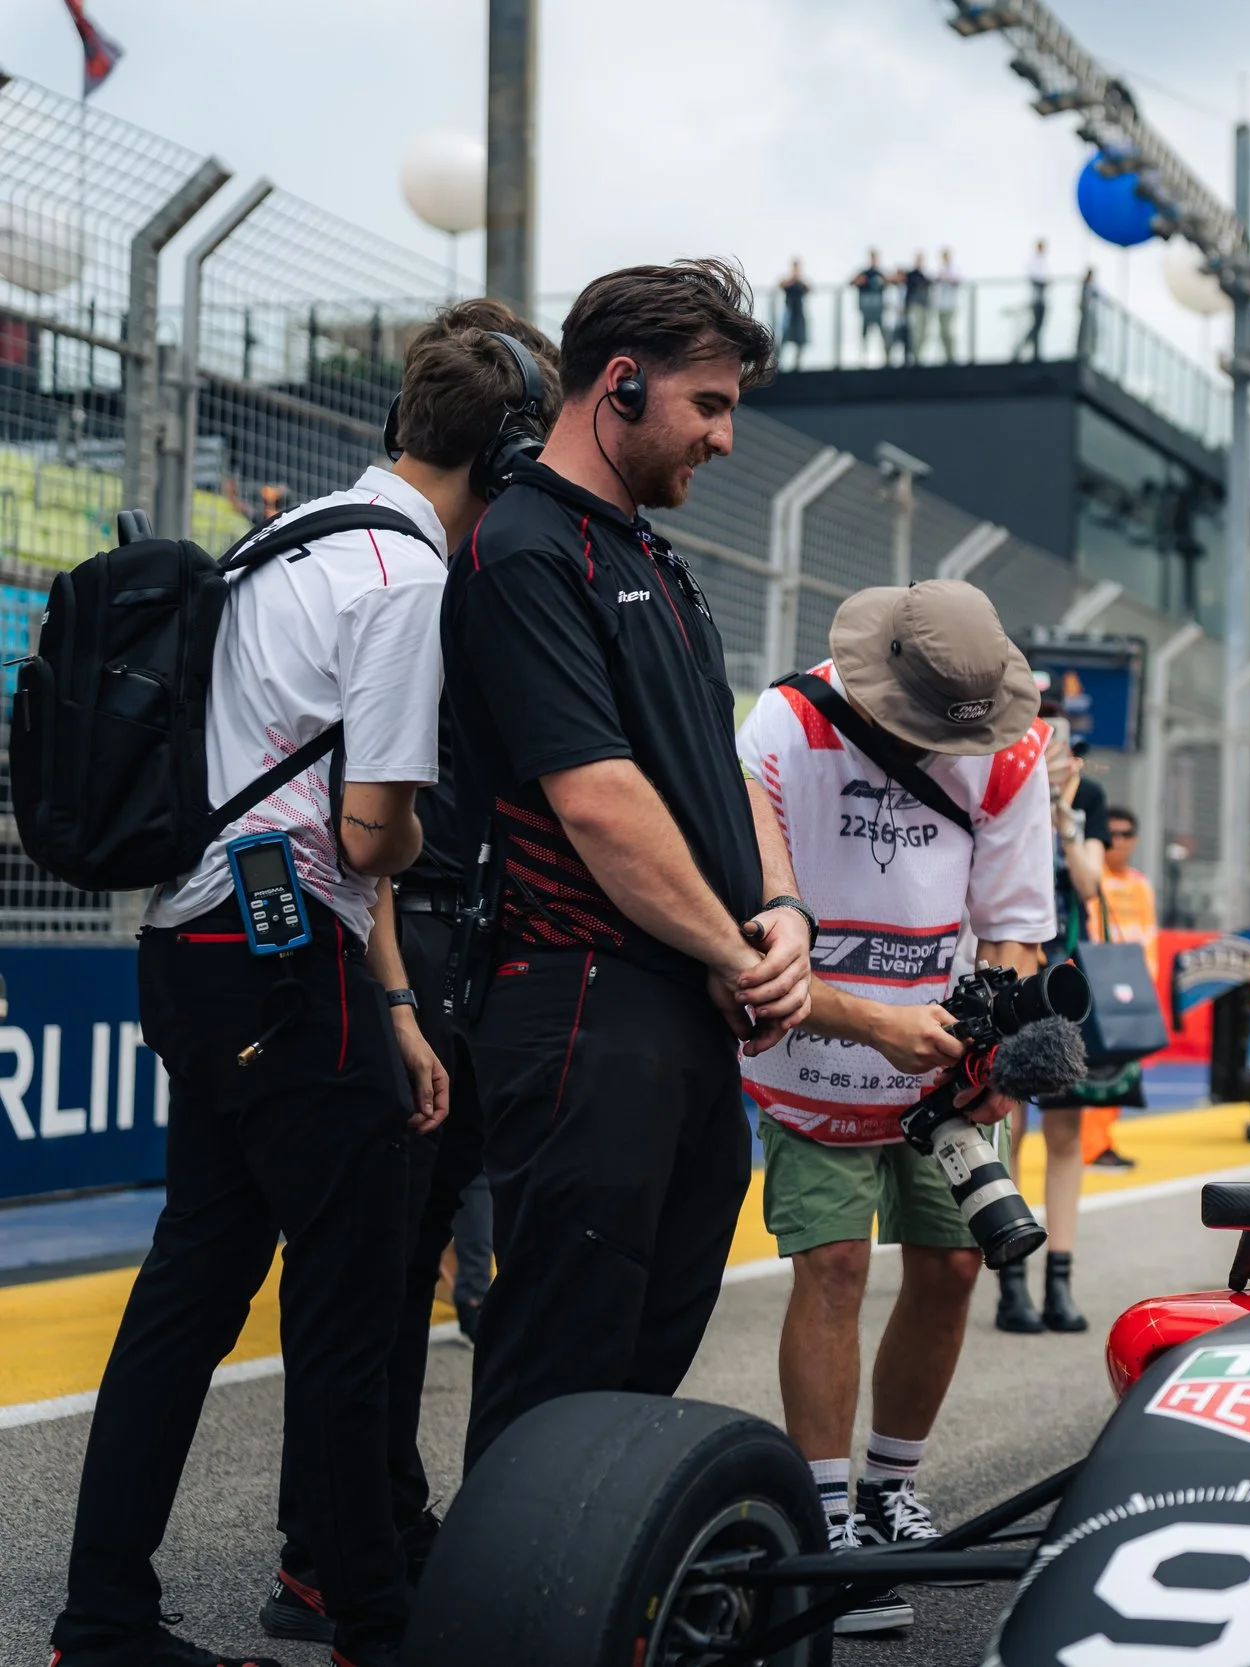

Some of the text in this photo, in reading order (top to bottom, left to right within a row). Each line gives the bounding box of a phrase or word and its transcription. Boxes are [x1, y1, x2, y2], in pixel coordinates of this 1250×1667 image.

[254, 886, 285, 898] PRISMA
[870, 938, 938, 959] Support
[868, 955, 925, 974] Event
